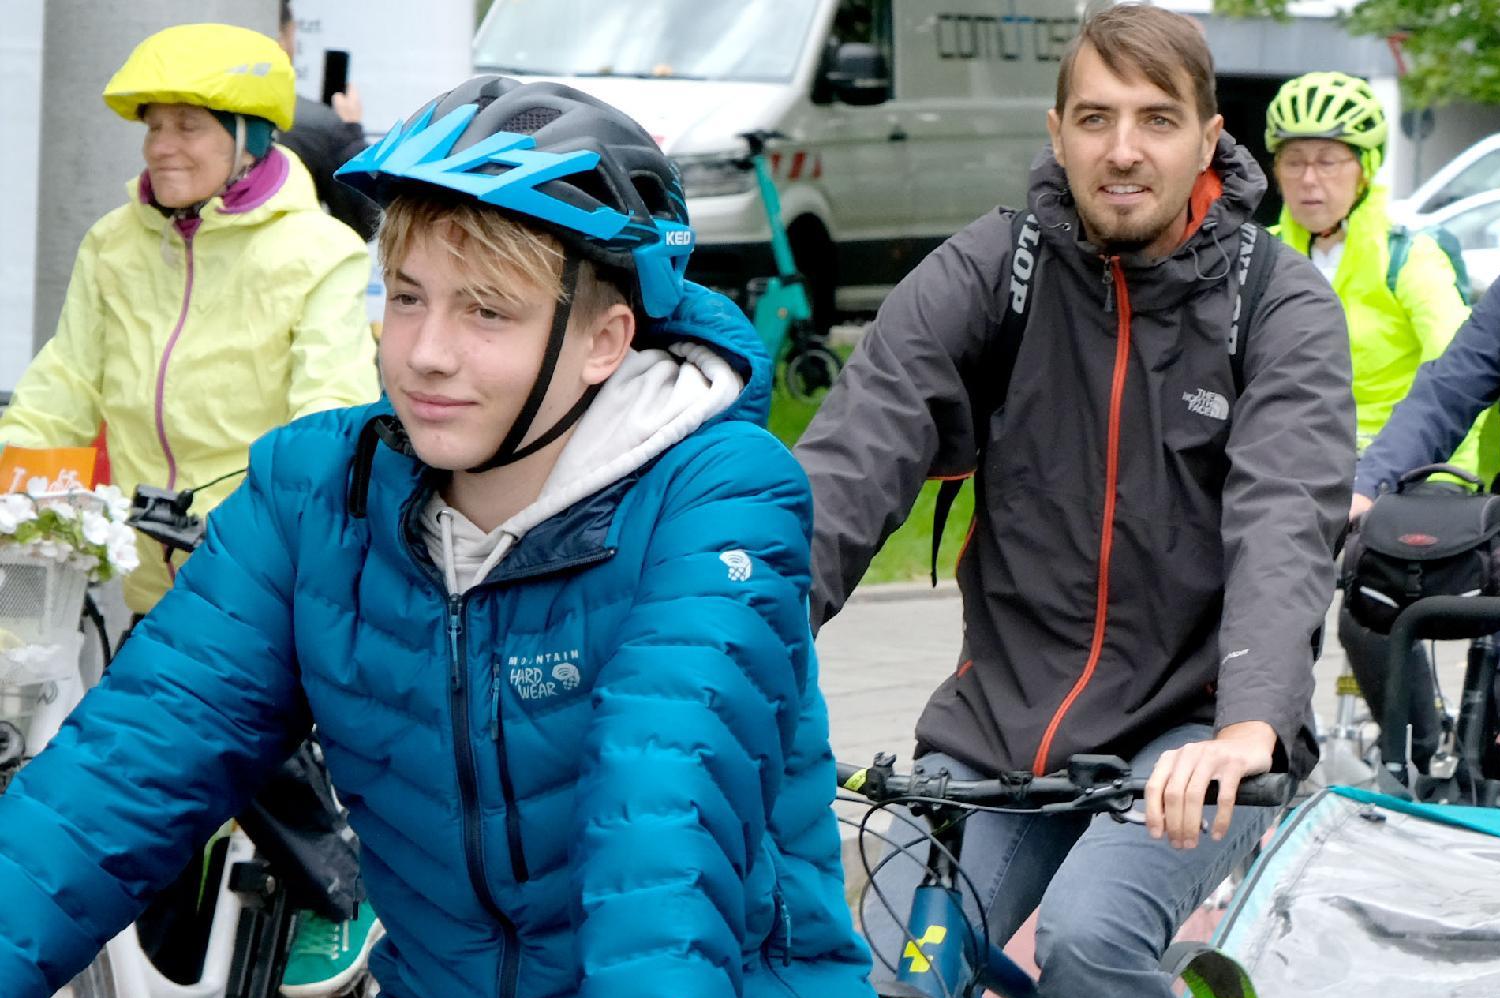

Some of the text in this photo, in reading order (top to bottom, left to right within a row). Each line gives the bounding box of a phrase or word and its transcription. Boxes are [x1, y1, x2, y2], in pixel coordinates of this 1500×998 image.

[665, 231, 691, 246] KED
[1010, 213, 1040, 314] LOP
[508, 649, 579, 665] MOUNTAIN
[510, 668, 543, 686] HARD
[518, 682, 560, 700] WEAR
